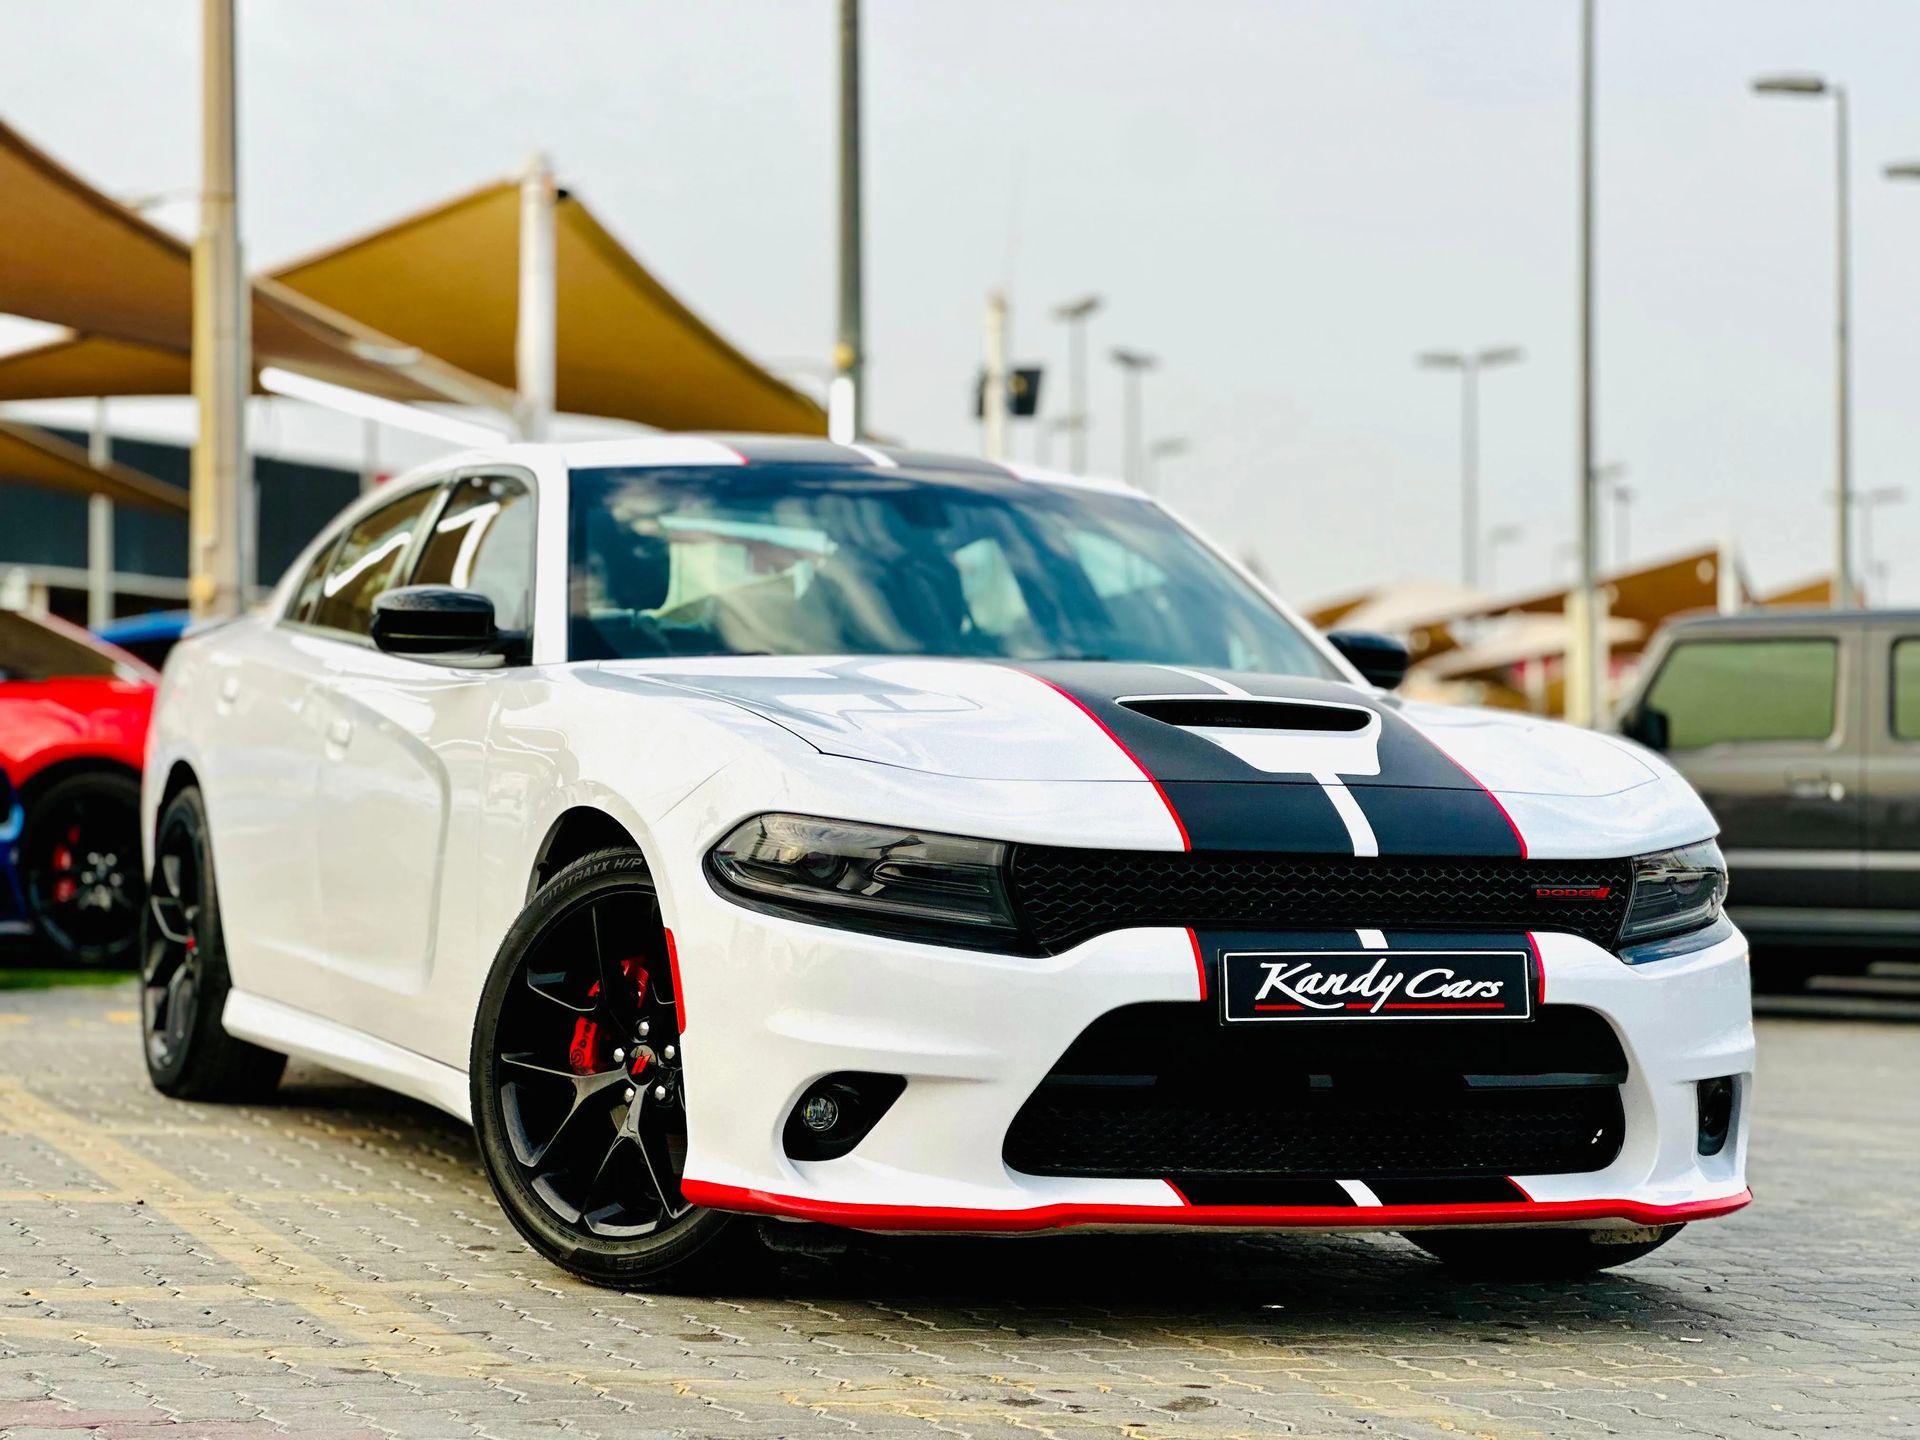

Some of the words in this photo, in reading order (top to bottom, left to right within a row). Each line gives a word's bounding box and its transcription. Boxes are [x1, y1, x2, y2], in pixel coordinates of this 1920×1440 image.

[541, 861, 610, 906] CITYTRAXX
[613, 858, 643, 870] H/P
[1536, 888, 1603, 897] DODGE
[1255, 958, 1403, 1013] Kandy
[1405, 968, 1504, 999] Cars
